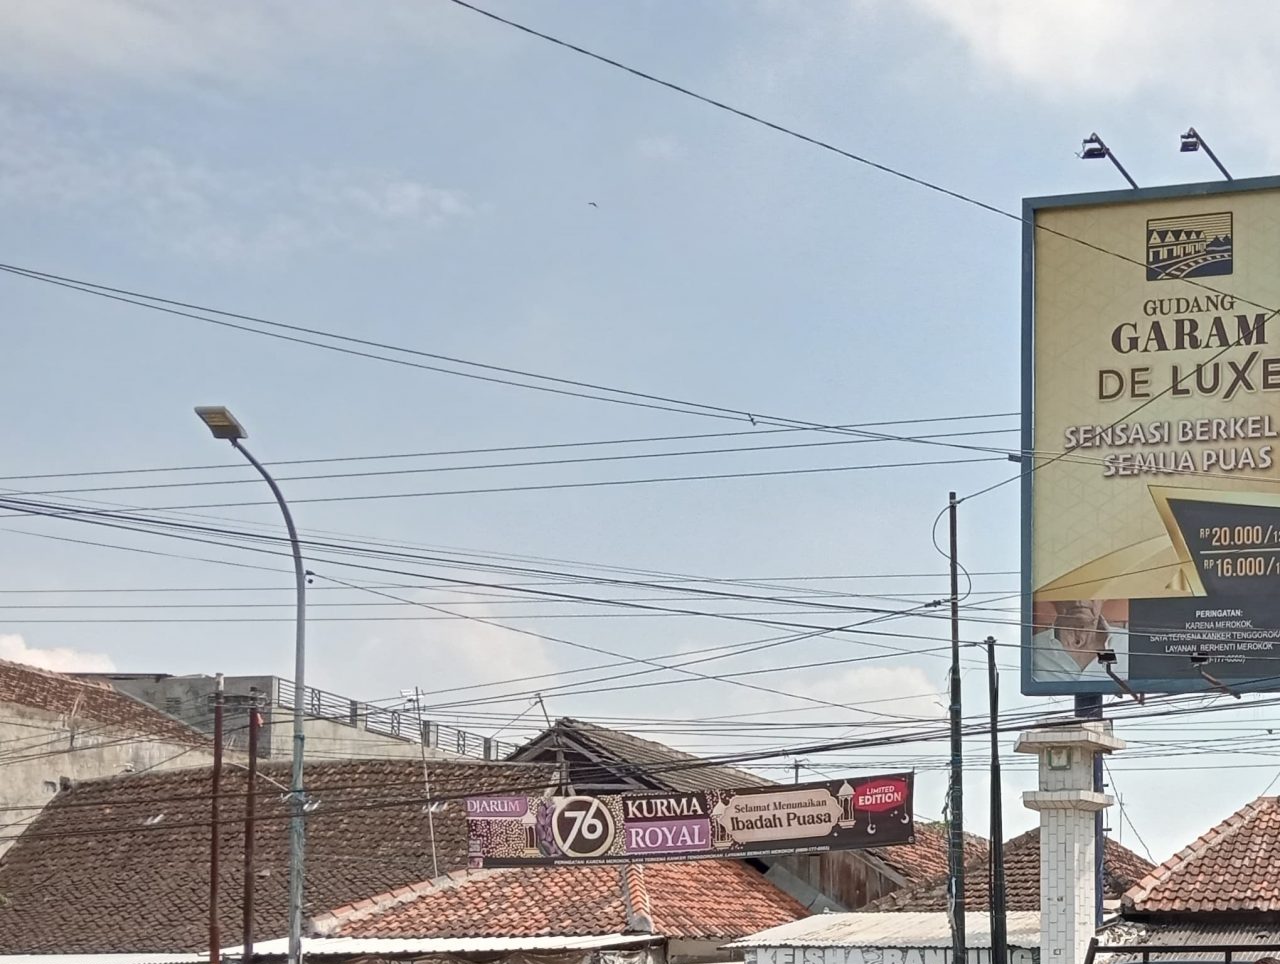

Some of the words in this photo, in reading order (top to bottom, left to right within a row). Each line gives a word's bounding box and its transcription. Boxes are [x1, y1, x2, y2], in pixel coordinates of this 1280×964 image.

[1143, 295, 1236, 316] GUDANG
[1111, 313, 1269, 354] GARAM
[1098, 367, 1151, 401] DE
[1064, 421, 1171, 450] SENSASI
[1102, 451, 1195, 477] SEMUA
[1202, 446, 1273, 471] PUAS
[1195, 609, 1244, 618] PERINGATAN:
[1185, 622, 1215, 630] KARENA
[1201, 632, 1231, 640] KANKER
[1165, 644, 1197, 653] LAYANAN
[1200, 643, 1236, 652] BERHENTI
[1237, 642, 1273, 651] MEROKOK
[858, 791, 902, 806] EDITION
[866, 785, 895, 795] LIMITED
[466, 799, 520, 813] DJARUM
[626, 797, 704, 819] KURMA
[734, 802, 770, 814] Selamat
[772, 799, 827, 811] Menunaikan
[561, 798, 604, 852] 76
[730, 812, 783, 831] Ibadah
[787, 811, 832, 828] Puasa
[629, 824, 706, 849] ROYAL
